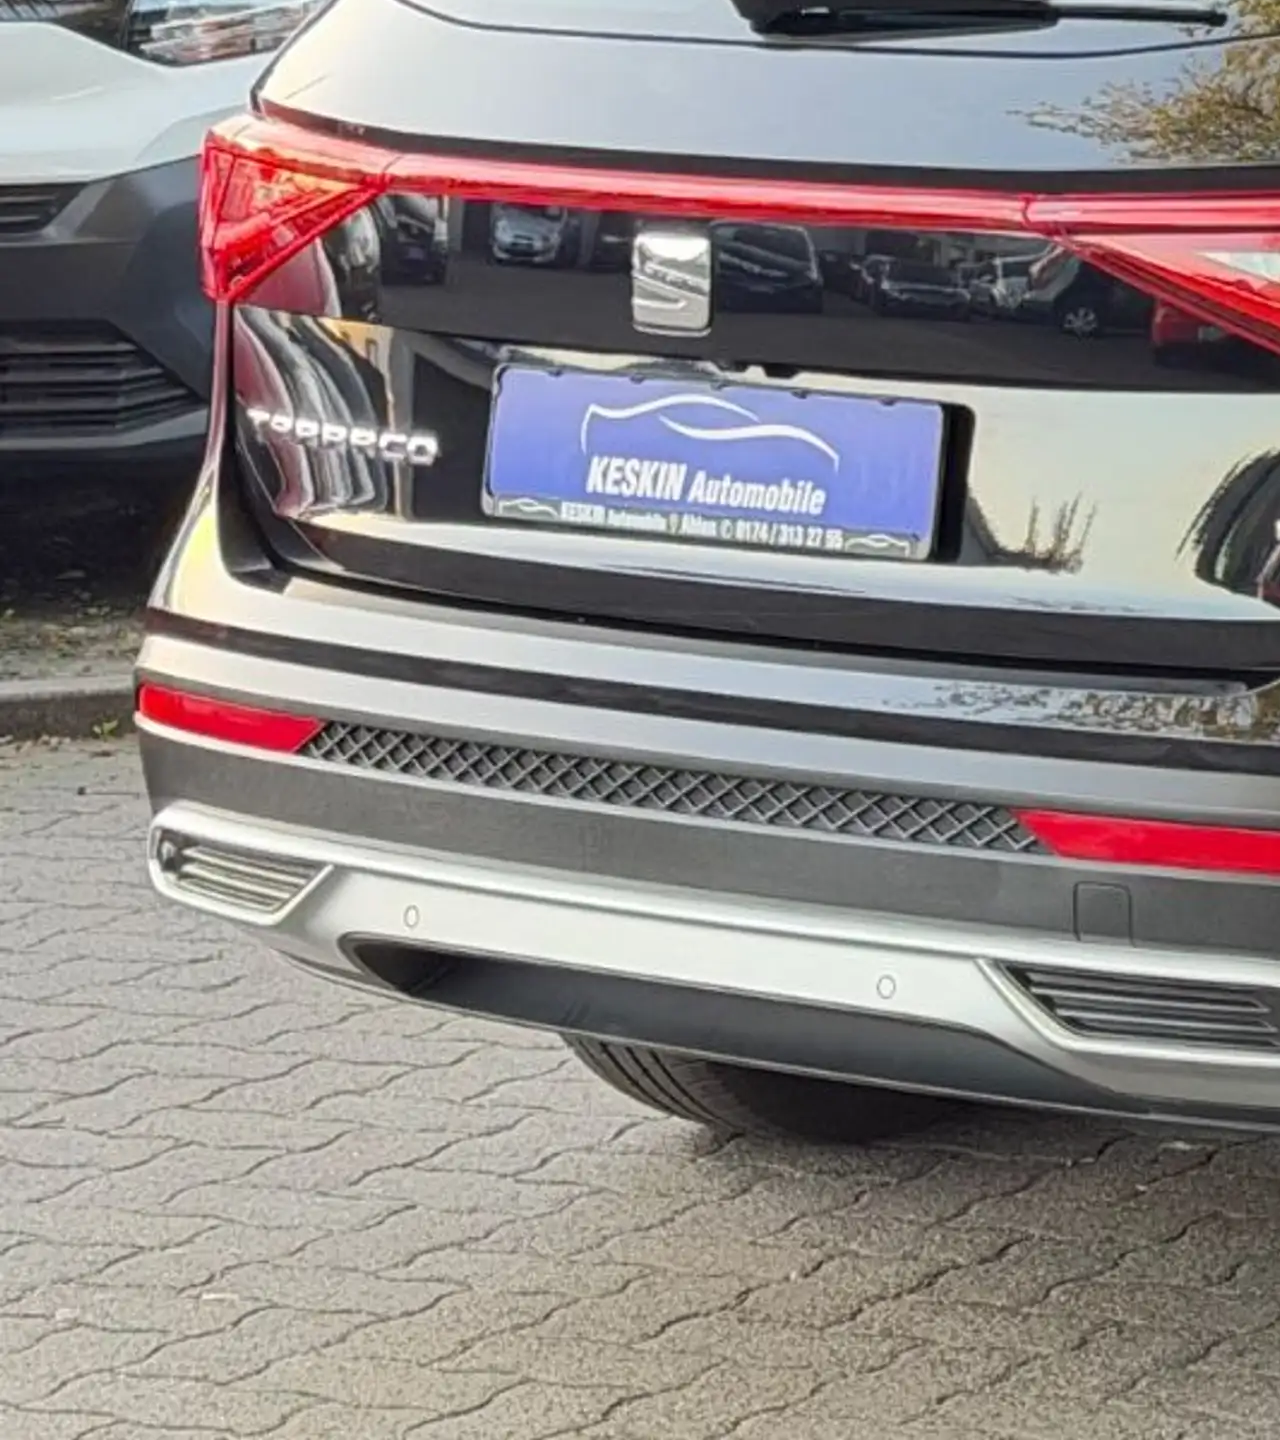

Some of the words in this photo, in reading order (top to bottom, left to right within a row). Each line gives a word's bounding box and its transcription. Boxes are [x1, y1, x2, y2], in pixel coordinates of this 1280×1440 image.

[586, 455, 688, 502] KESKIN
[688, 469, 828, 516] Automobile
[560, 501, 606, 526] KESKIN
